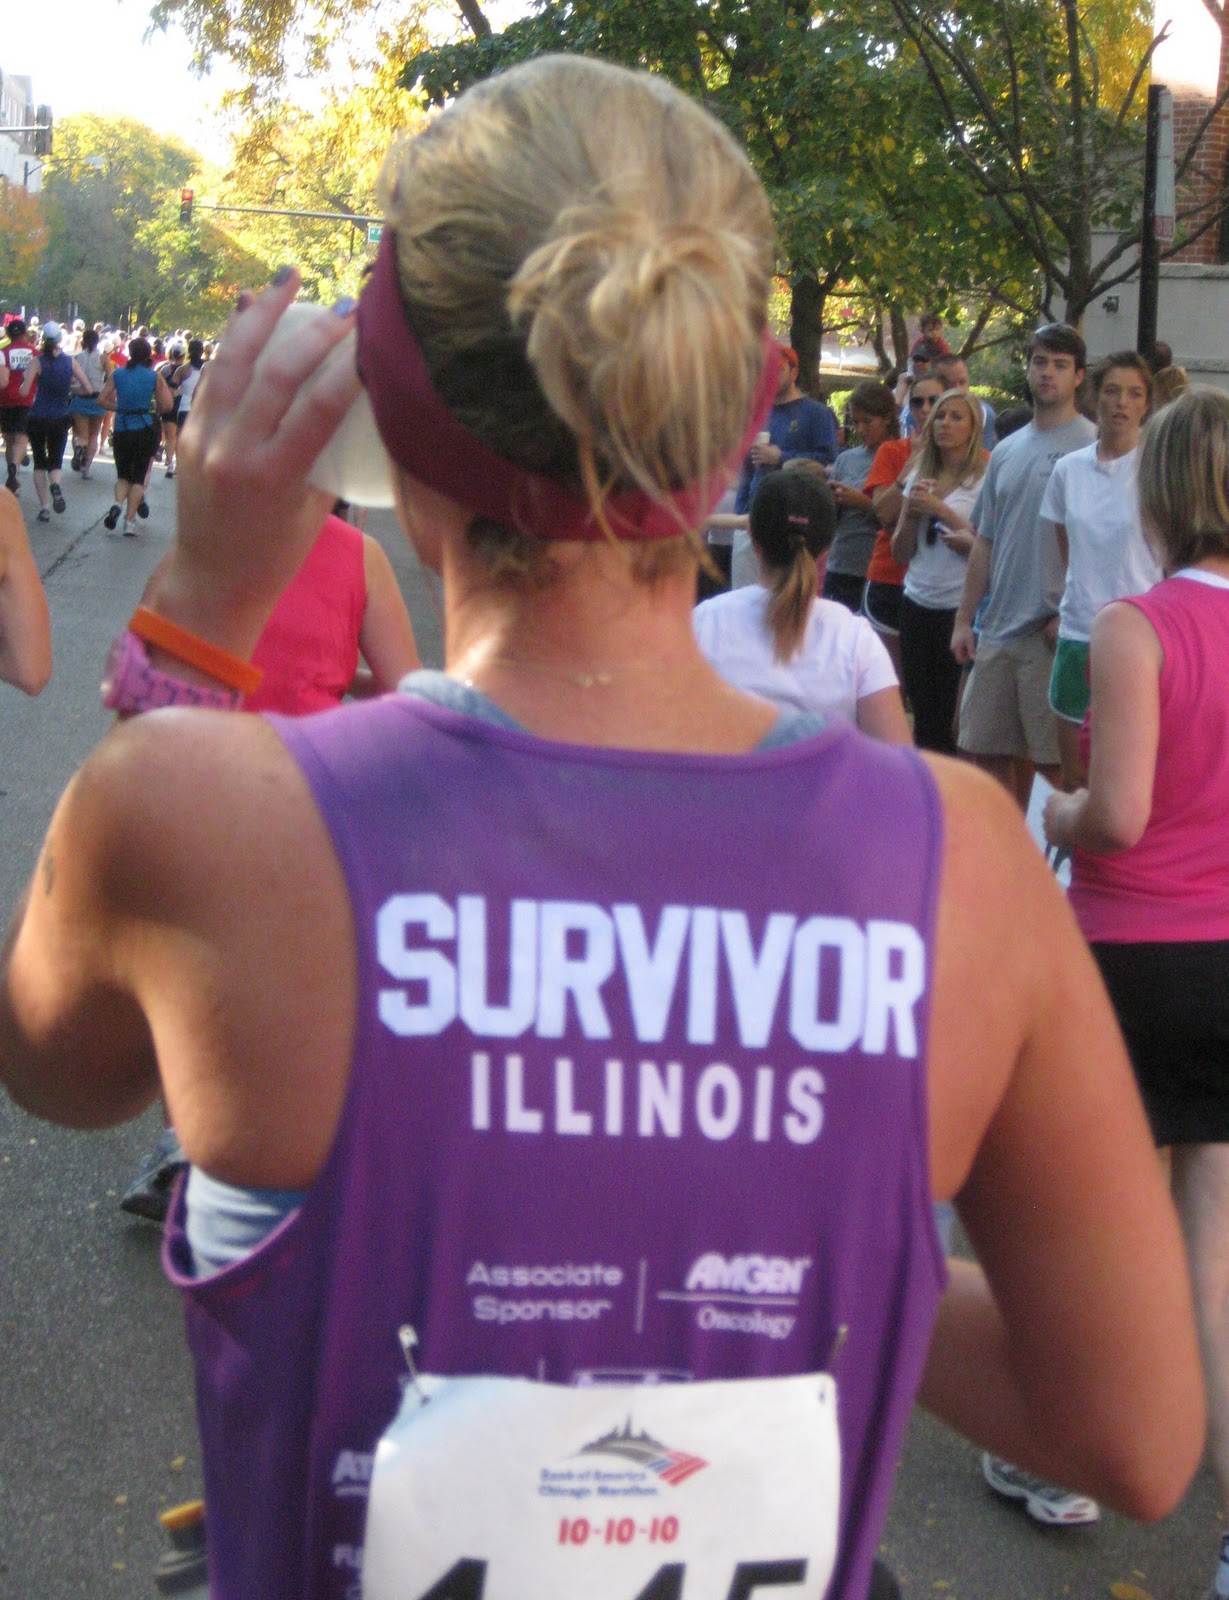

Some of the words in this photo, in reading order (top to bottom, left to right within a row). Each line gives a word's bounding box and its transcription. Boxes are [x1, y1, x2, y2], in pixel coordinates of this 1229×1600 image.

[377, 893, 926, 1058] SURVIVOR
[471, 1051, 825, 1144] ILLINOIS
[466, 1260, 624, 1287] Associate
[685, 1252, 804, 1294] AMGEN
[473, 1295, 612, 1325] Sponsor
[698, 1305, 796, 1340] Oncology
[558, 1515, 679, 1546] 10-10-10
